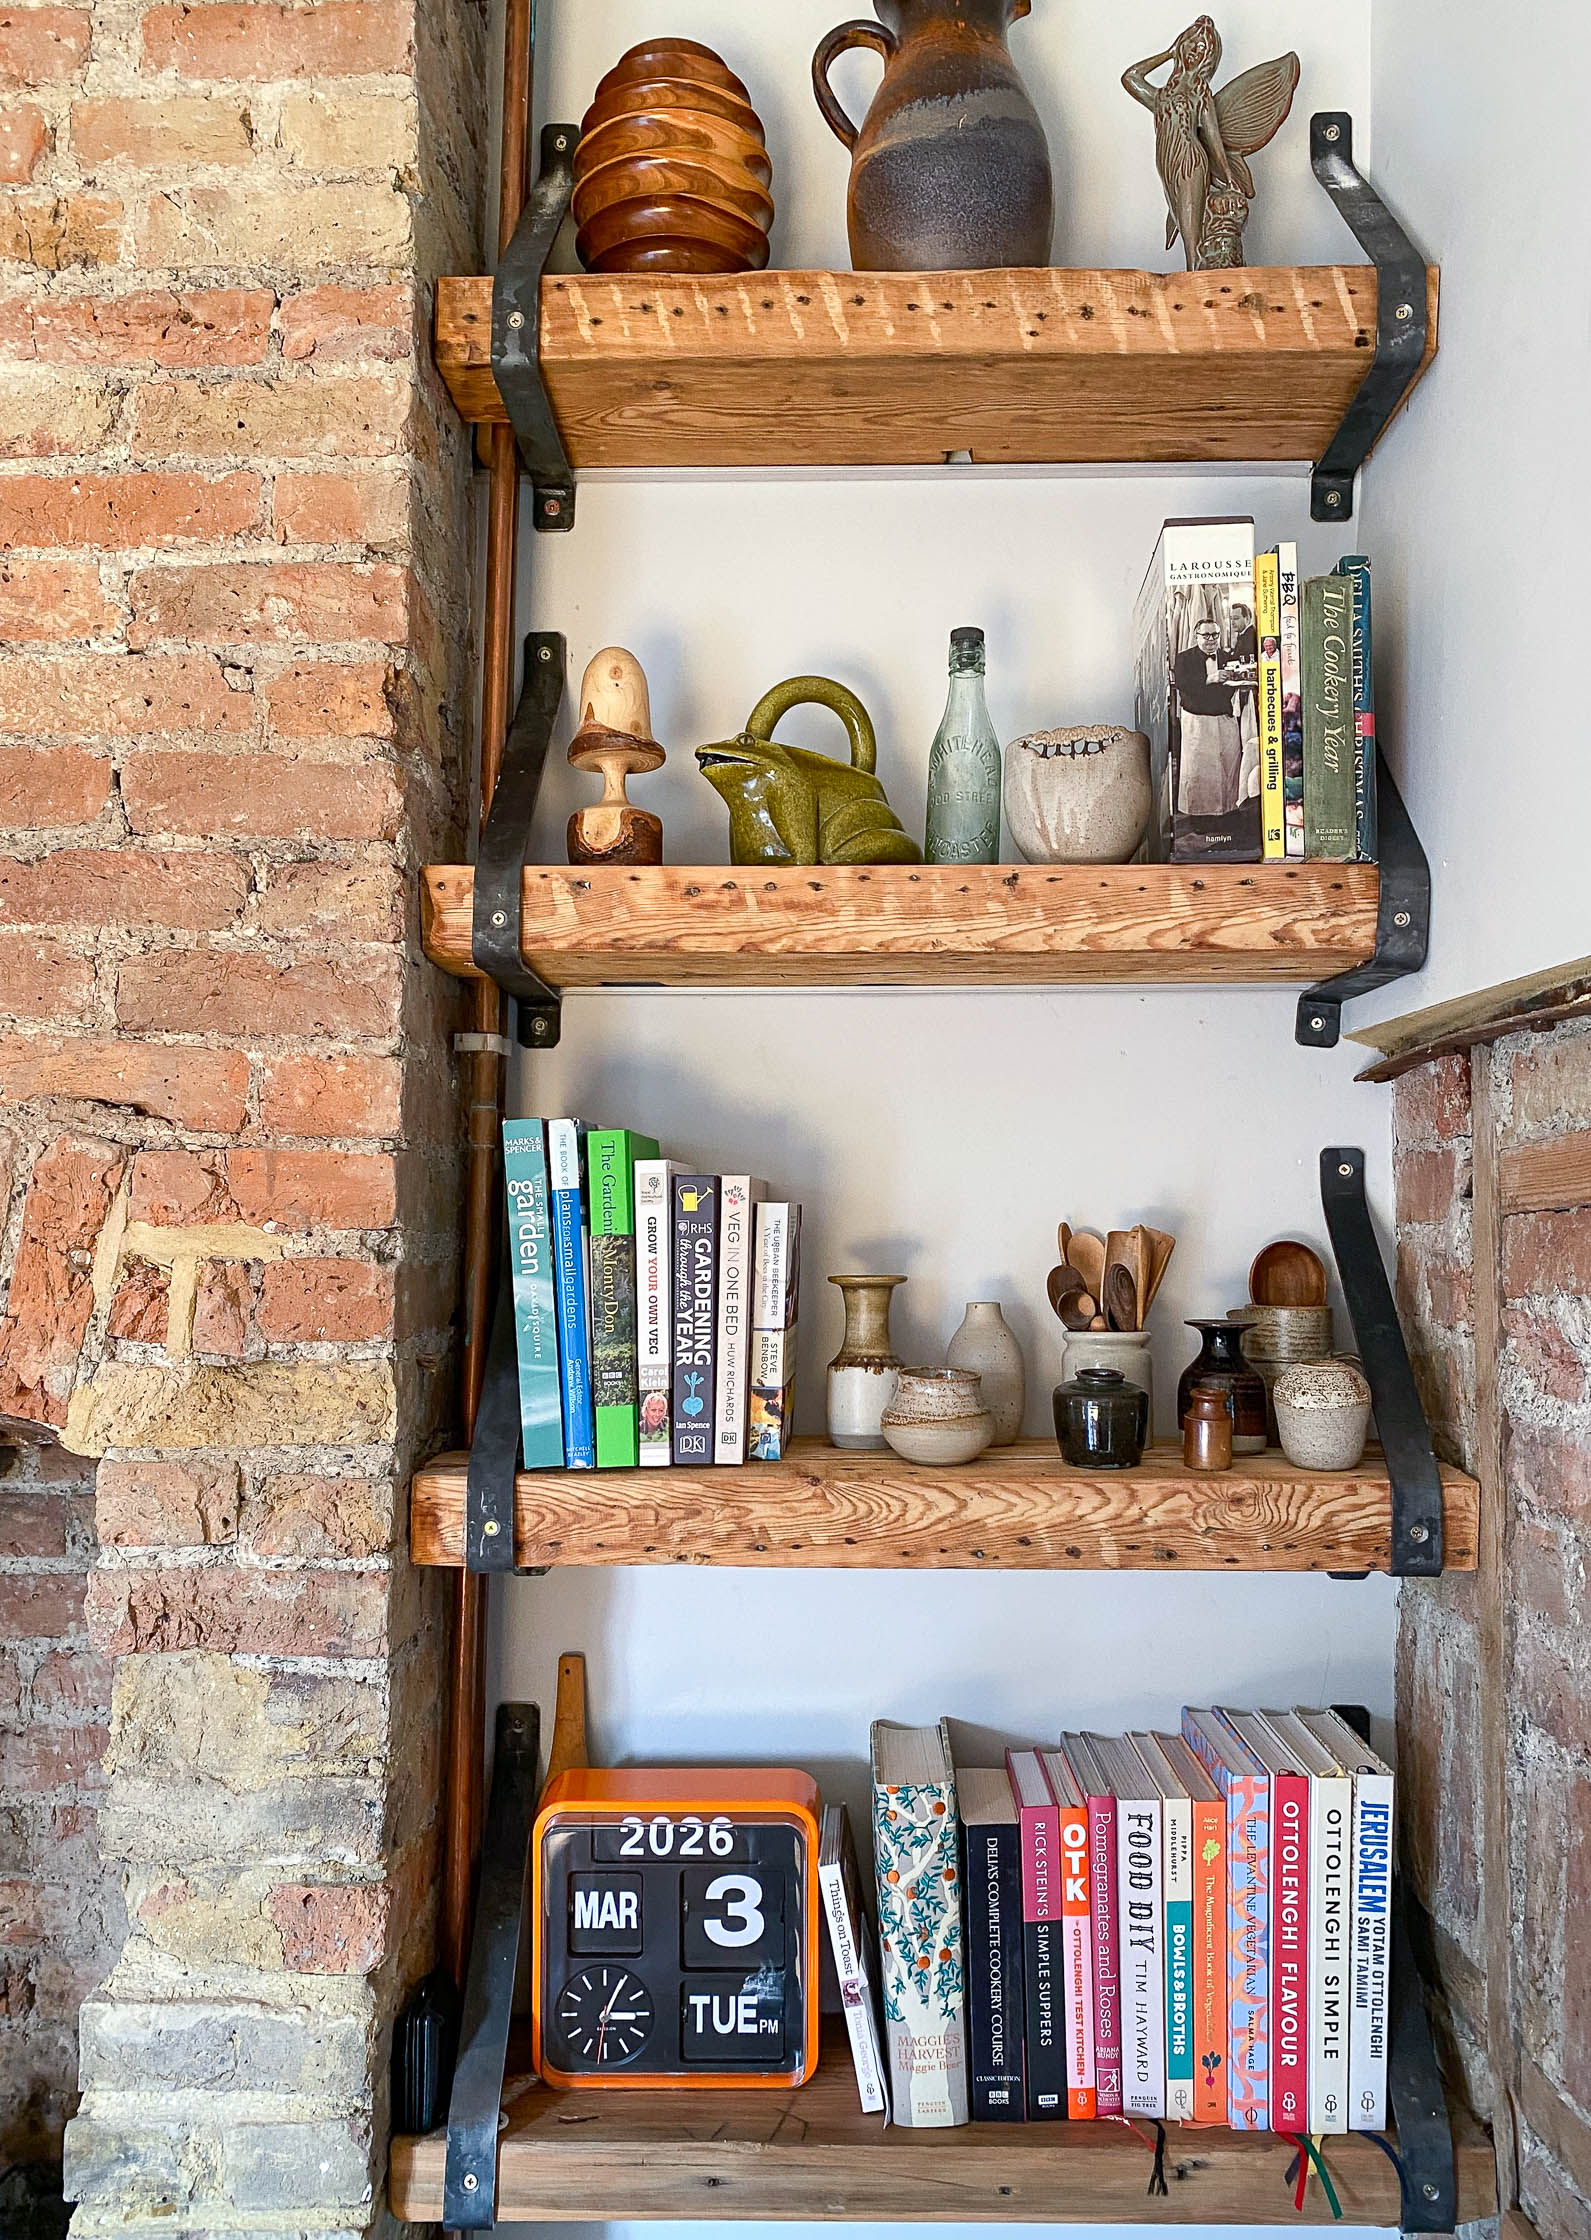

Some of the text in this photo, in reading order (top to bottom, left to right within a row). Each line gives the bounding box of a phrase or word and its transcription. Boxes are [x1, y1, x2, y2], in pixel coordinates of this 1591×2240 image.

[1170, 559, 1252, 571] LAROUSSE
[1170, 571, 1252, 580] GASTRONOMIQUE
[1281, 571, 1297, 606] BBQ
[1315, 586, 1347, 774] The Cookery Year
[1266, 668, 1279, 790] barbecues & grilling
[1205, 835, 1232, 843] hamlyn
[505, 1137, 534, 1147] MARKS
[505, 1145, 544, 1155] SPENCER
[560, 1150, 568, 1174] BOOK
[534, 1177, 545, 1232] THE SMALL
[561, 1176, 569, 1187] OF
[601, 1140, 618, 1237] The Gardeni
[508, 1179, 545, 1275] garden
[690, 1223, 713, 1234] RHS
[600, 1249, 619, 1333] Monty Don
[647, 1216, 659, 1355] GROW YOUR OWN VEG
[770, 1219, 781, 1317] THE URBAN BEEKEEPER
[676, 1238, 694, 1366] through the YEAR
[694, 1238, 713, 1366] GARDENING
[725, 1212, 740, 1422] VEG IN ONE BED HUW RICHARDS
[532, 1320, 542, 1359] SQUIRE
[760, 1336, 769, 1379] BENBOW
[769, 1343, 778, 1373] STEVE
[567, 1359, 577, 1414] Andrew Wilson
[574, 1359, 582, 1384] General
[640, 1367, 668, 1377] Carol
[640, 1378, 668, 1387] Klein
[683, 1436, 703, 1450] DK
[686, 1421, 711, 1430] Spence
[619, 1816, 736, 1856] 2026
[1063, 1823, 1088, 1902] OTK
[1205, 1874, 1215, 1893] The
[574, 1891, 639, 1930] MAR
[703, 1874, 765, 1948] 3
[829, 1879, 853, 1975] Things on Toast
[987, 1881, 1001, 1948] COMPLETE
[1034, 1822, 1053, 2047] RICK STEIN'S SIMPLE SUPPERS
[1092, 1811, 1117, 2039] Pomegranates and Roses
[1205, 1895, 1216, 1949] Magnificent
[1280, 1801, 1300, 2067] OTTOLENGHI FLAVOUR
[1324, 1809, 1342, 2059] OTTOLENGHI SIMPLE
[1357, 1800, 1390, 2059] JERUSALEM YOTAM OTTOLENGHI
[1127, 1813, 1155, 2083] FOOD DIY TIM HAYWARD
[1206, 1952, 1215, 1977] Book
[1246, 1817, 1257, 2070] THE LEVANTINE VEGETARIAN SALMA HAGE
[1356, 1916, 1370, 2009] SAMI TAMIMI
[989, 1949, 1002, 2012] COOKERY
[1073, 1928, 1085, 2077] OTTOLENGHI TEST KITCHEN
[1206, 1978, 1214, 1990] of
[688, 1995, 779, 2035] TUE PM
[991, 2014, 1004, 2067] COURSE
[898, 2046, 961, 2060] HARVEST
[898, 2060, 961, 2074] Maggie Beer
[988, 2090, 1009, 2098] BBC
